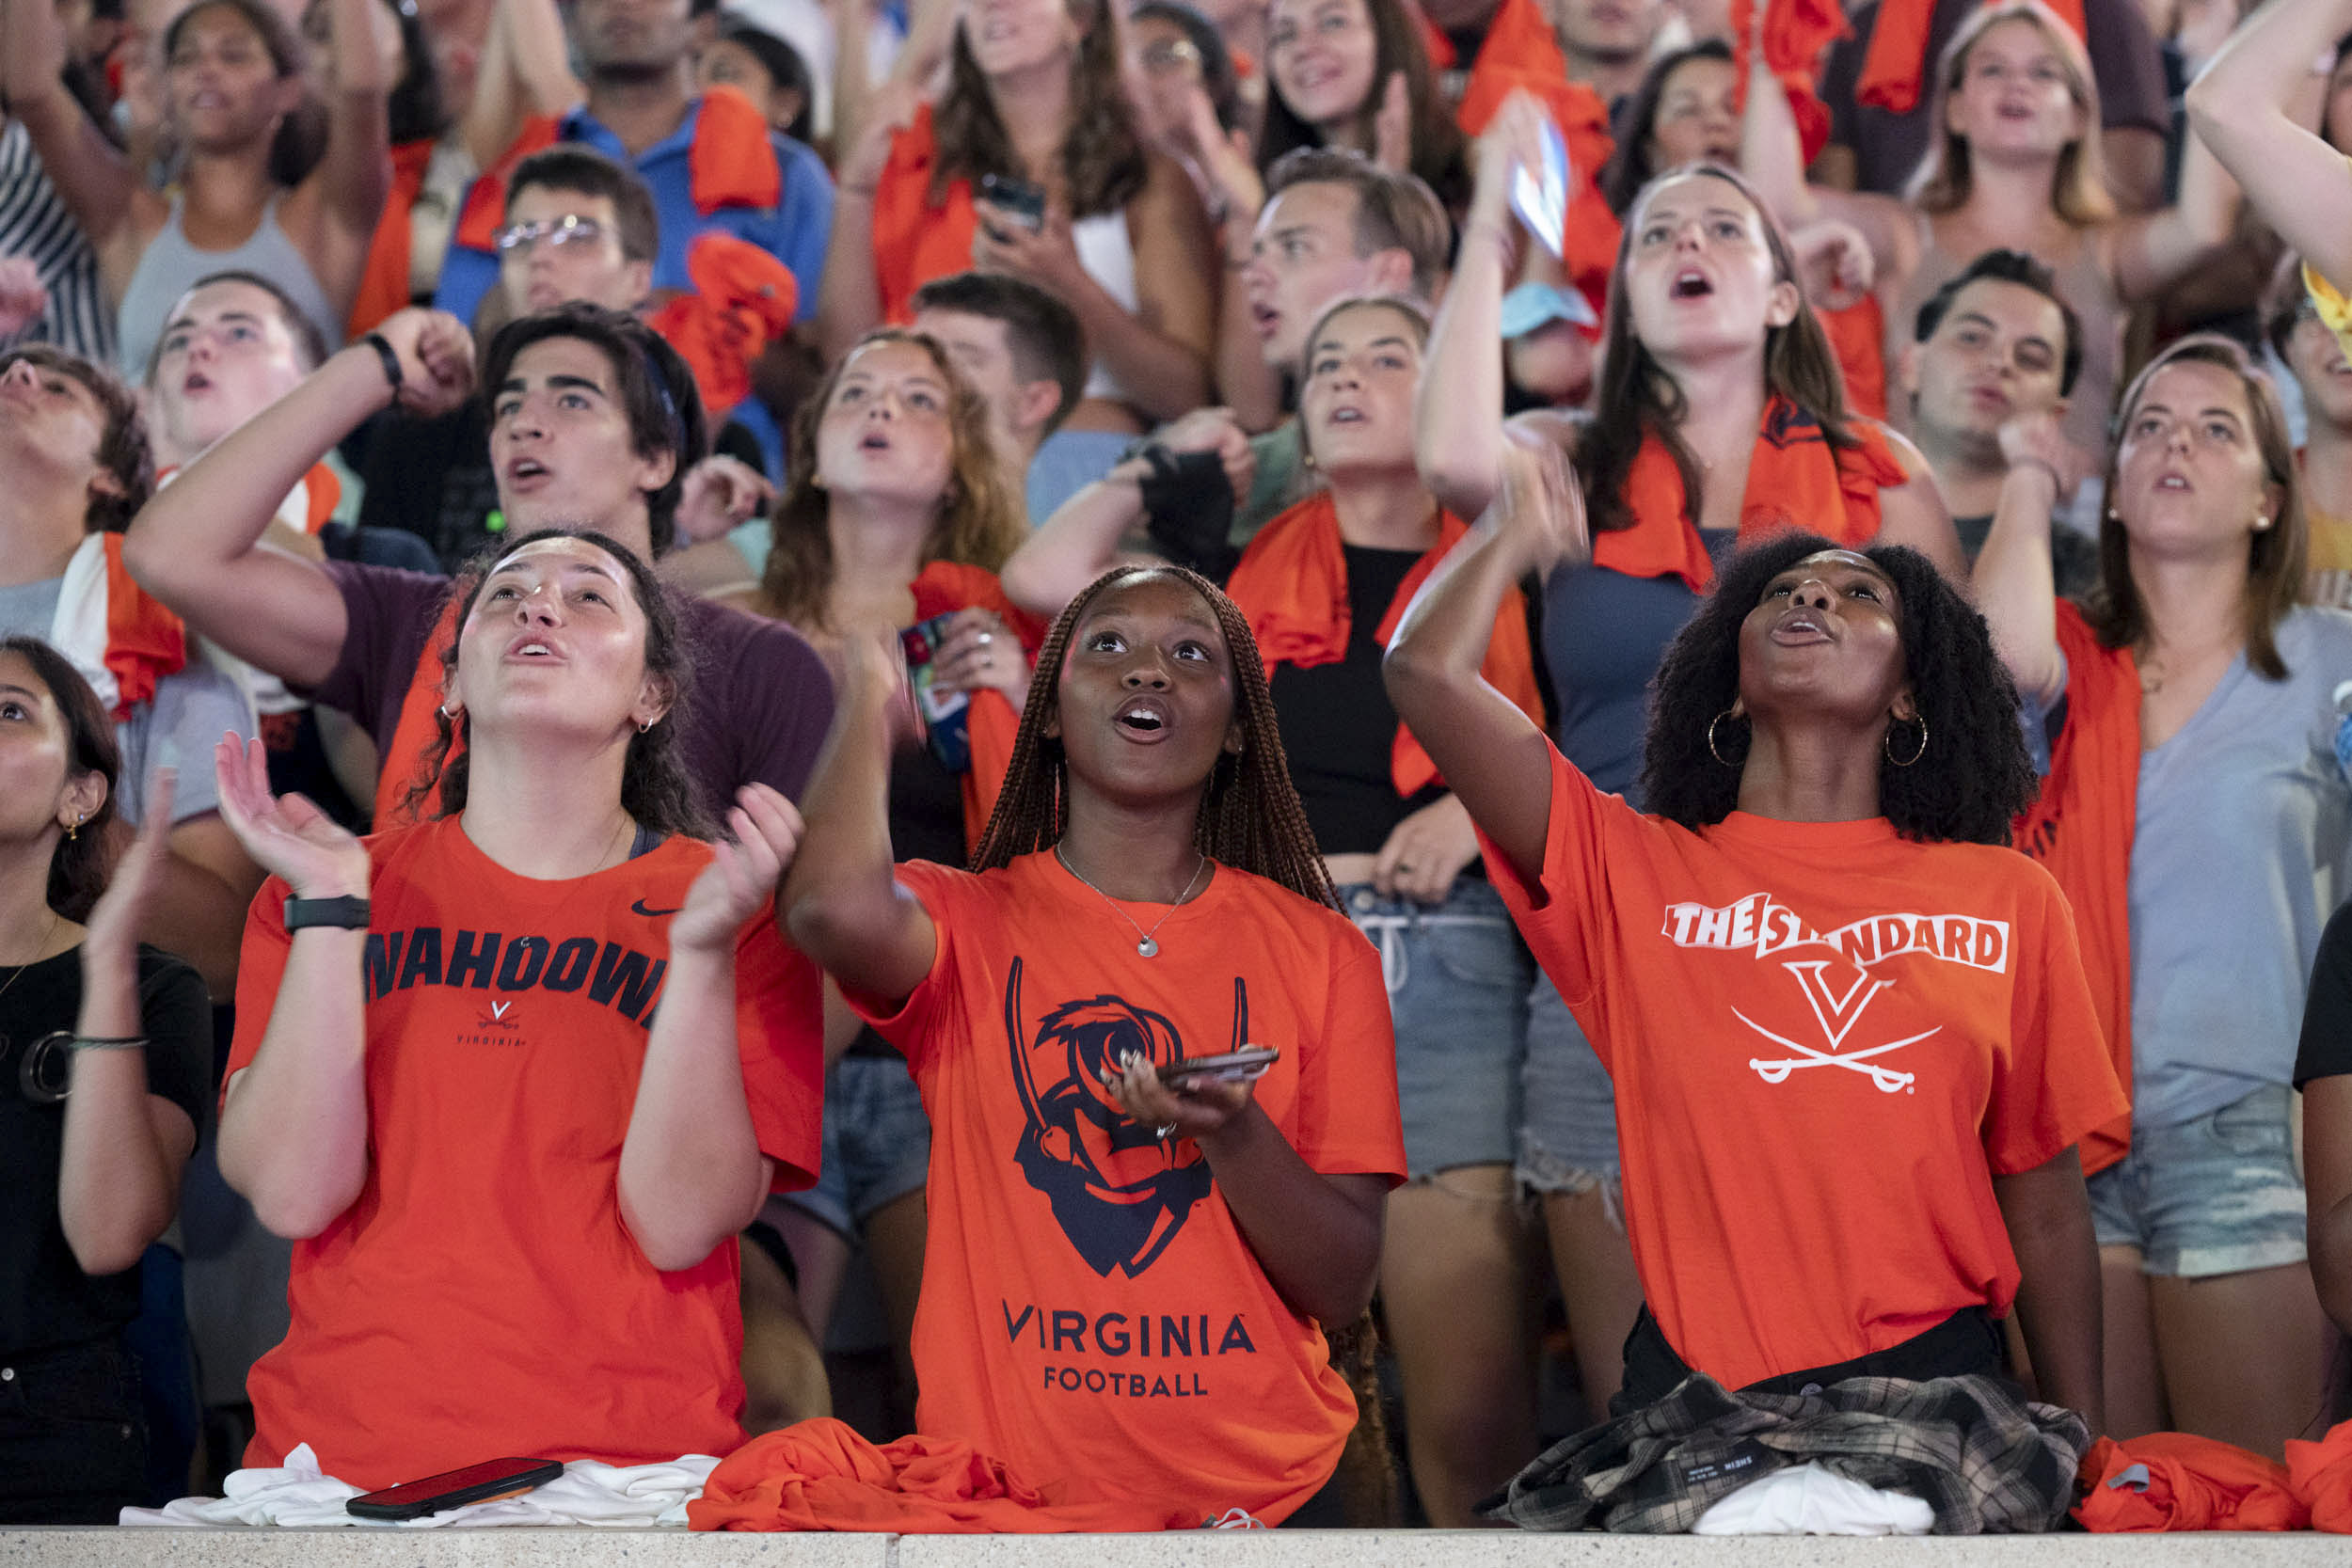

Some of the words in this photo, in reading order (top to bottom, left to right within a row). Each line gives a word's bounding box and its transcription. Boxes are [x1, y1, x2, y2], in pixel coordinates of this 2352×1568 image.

[1673, 897, 1756, 946] THE
[1002, 1297, 1257, 1357] VIRGINIA
[1043, 1367, 1208, 1398] FOOTBALL
